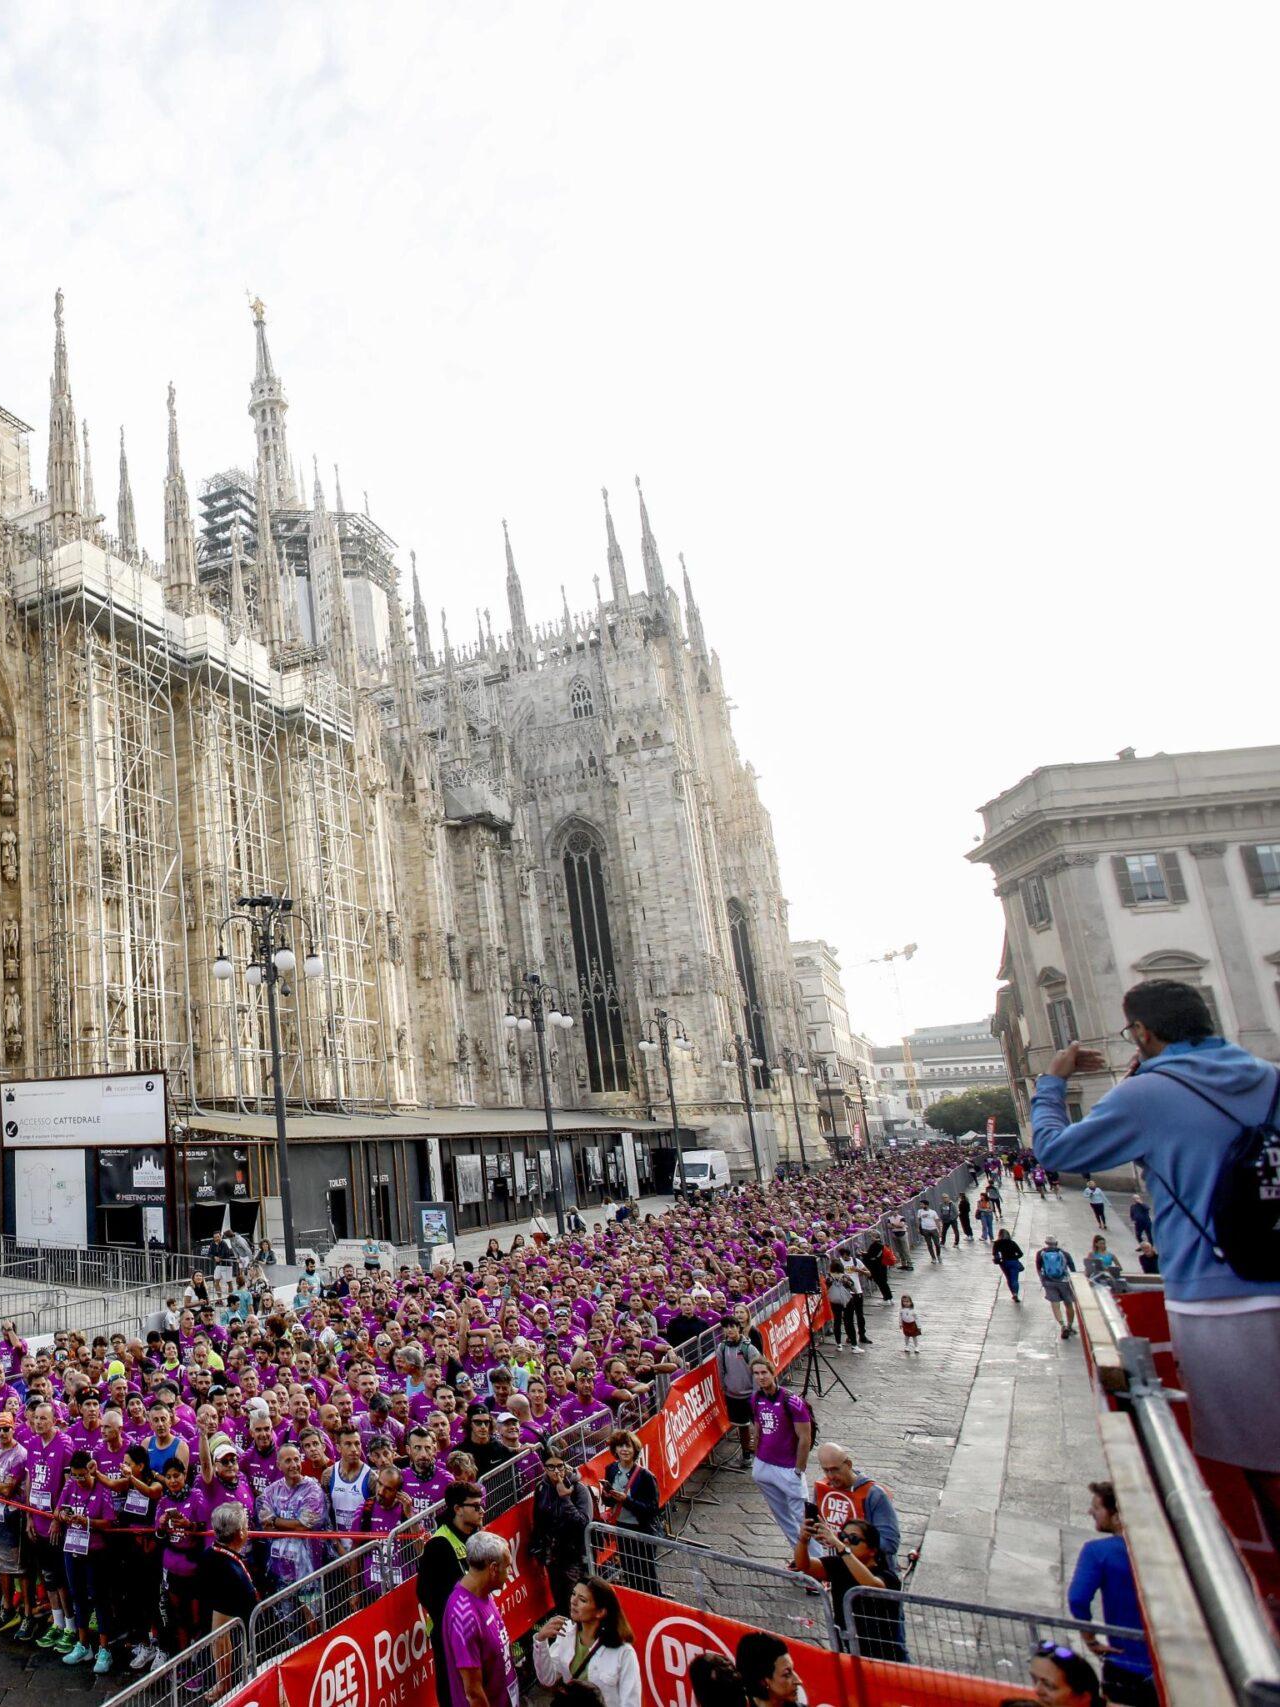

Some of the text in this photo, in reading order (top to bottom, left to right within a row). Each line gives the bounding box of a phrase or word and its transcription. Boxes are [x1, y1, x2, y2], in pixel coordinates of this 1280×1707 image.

[20, 1115, 101, 1126] ACCESSO CATTEDRALE
[329, 1178, 348, 1187] TOILETS
[372, 1174, 389, 1183] TOLETS
[669, 1399, 691, 1442] Radio
[683, 1375, 716, 1421] DEEJAY
[762, 1412, 774, 1420] DEE
[252, 1476, 267, 1486] DEE
[413, 1497, 430, 1509] DEE
[828, 1496, 850, 1512] DEE
[827, 1510, 849, 1525] JAY
[320, 1652, 357, 1707] DEE
[412, 1658, 435, 1690] NAT
